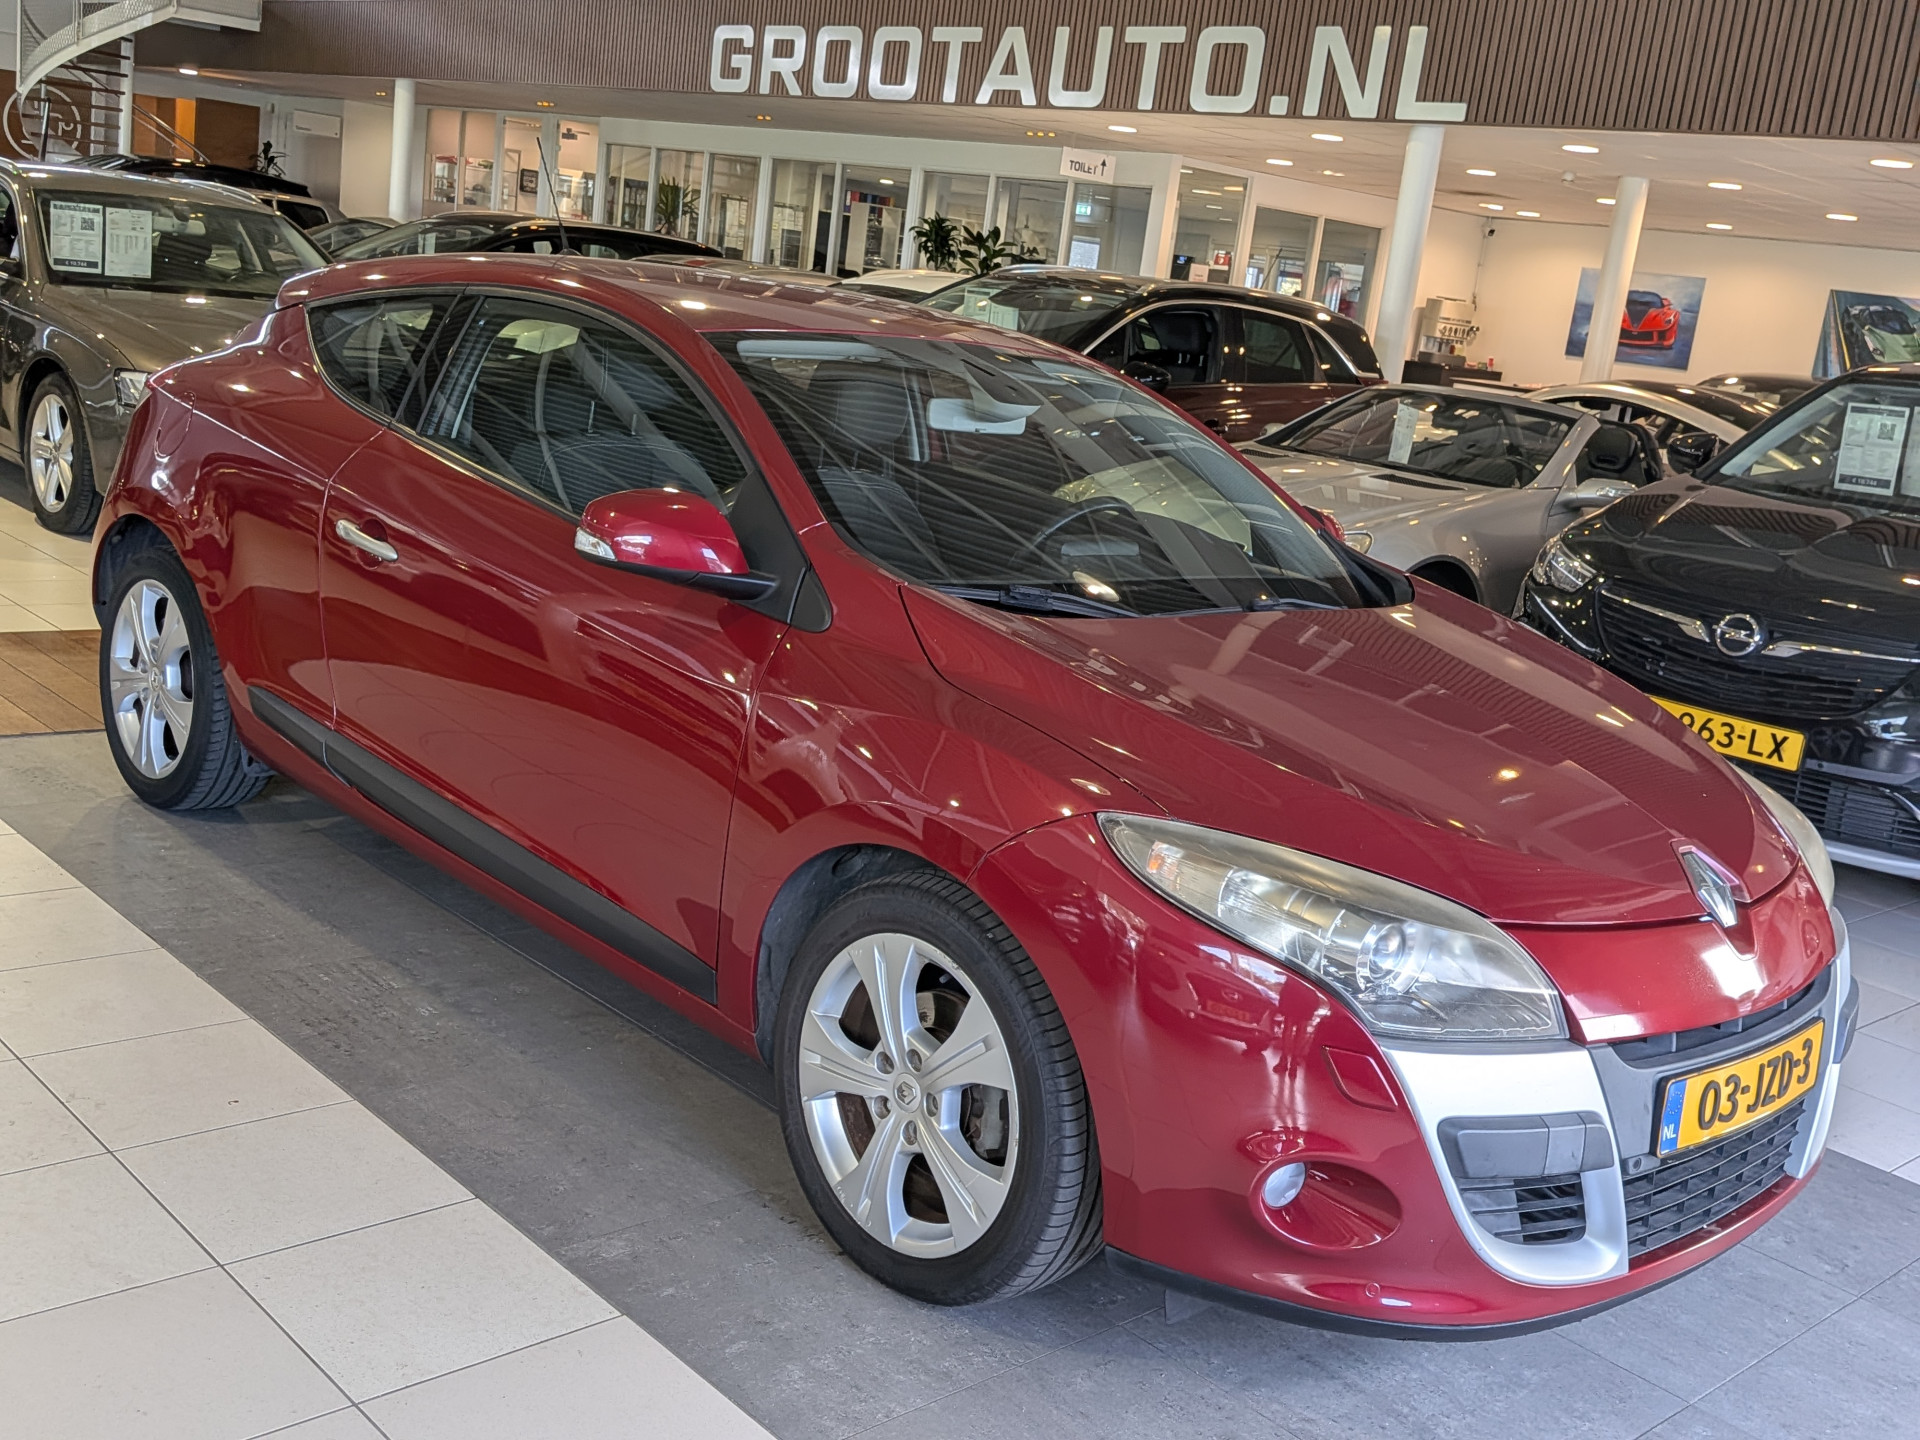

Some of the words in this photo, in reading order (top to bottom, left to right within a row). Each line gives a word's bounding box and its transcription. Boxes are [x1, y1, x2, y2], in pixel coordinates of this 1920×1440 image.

[710, 25, 1467, 122] GROOTAUTO.NL
[1069, 160, 1098, 175] TOILET
[1698, 1038, 1813, 1130] 03-JZD-3
[1663, 1124, 1677, 1141] NL
